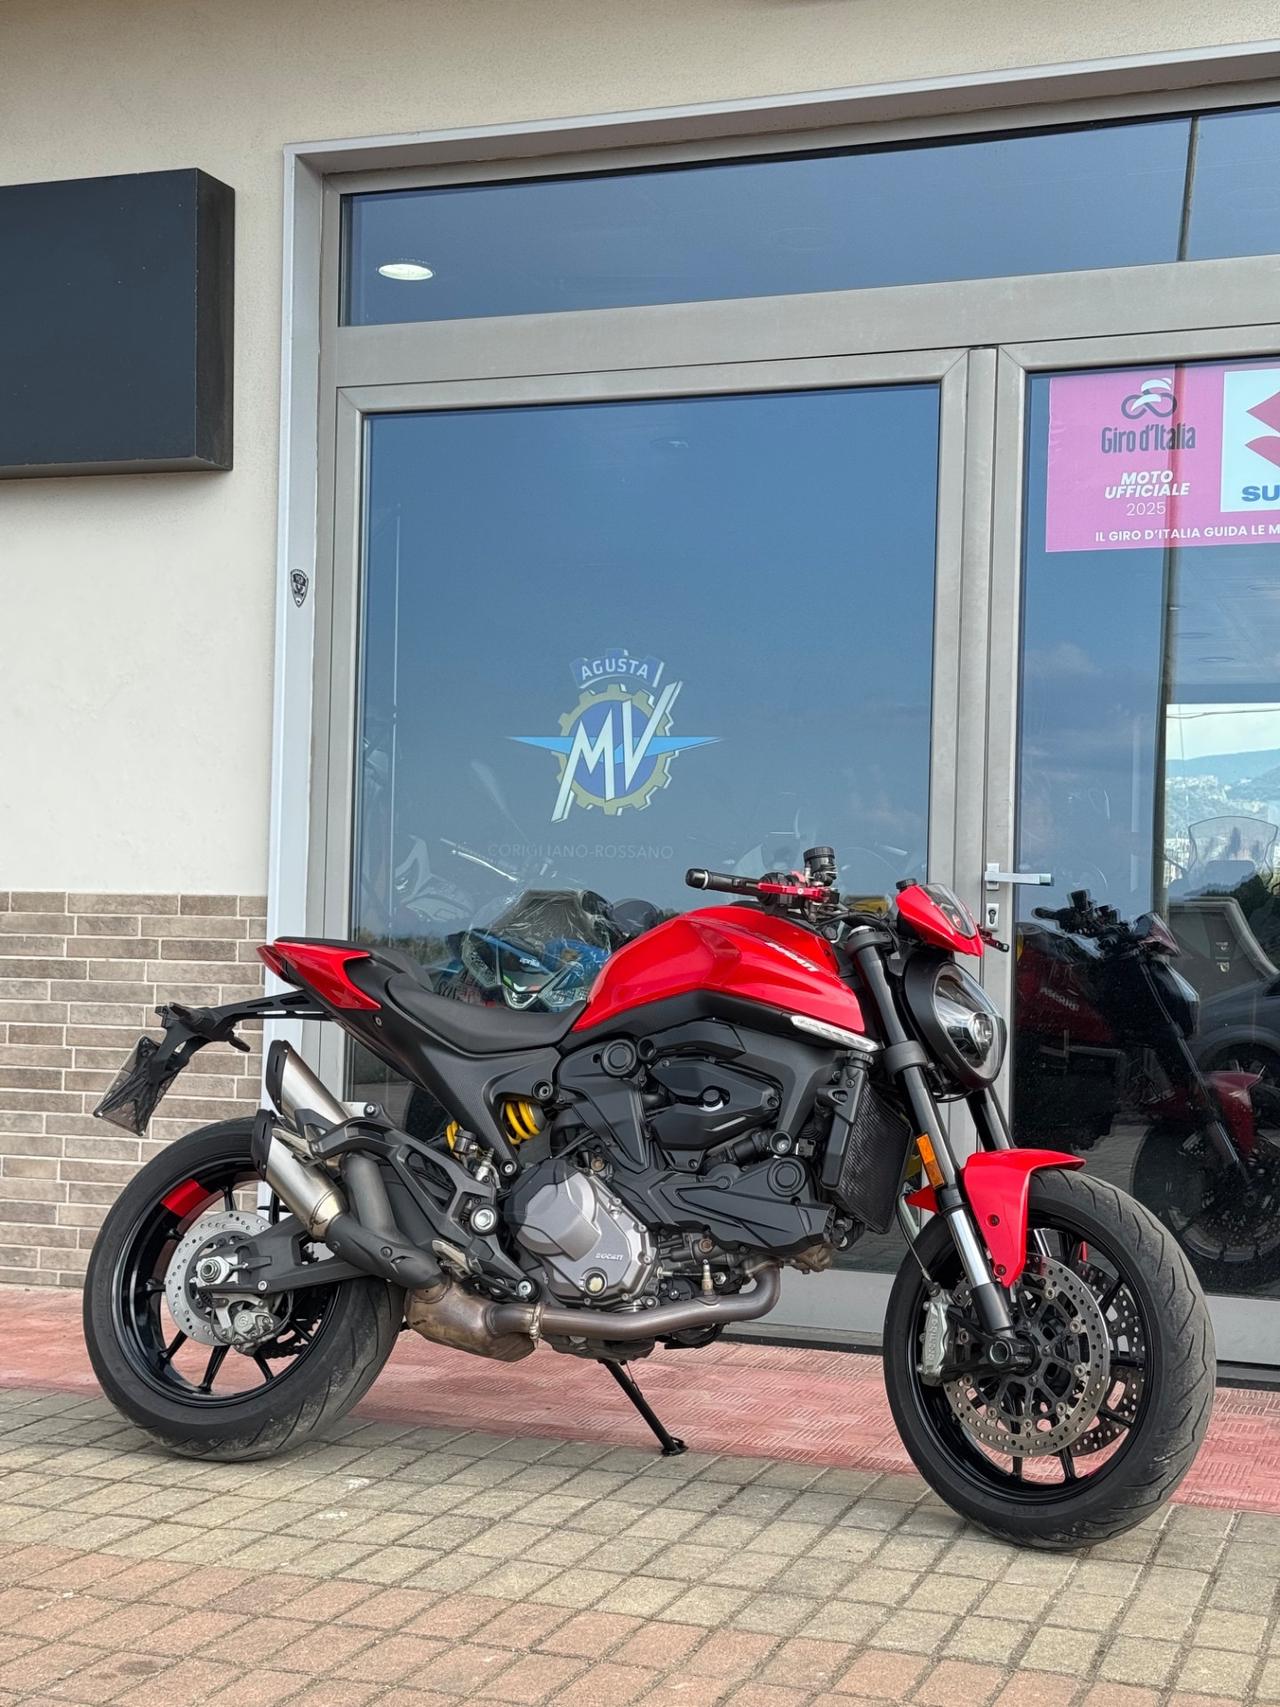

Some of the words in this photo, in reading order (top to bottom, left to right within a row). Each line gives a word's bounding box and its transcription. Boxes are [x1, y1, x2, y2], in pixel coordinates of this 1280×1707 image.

[1101, 426, 1137, 454] Giro
[1139, 422, 1196, 452] d'Italia
[1120, 470, 1174, 486] MOTO
[1104, 482, 1191, 499] UFFICIALE
[1126, 501, 1167, 516] 2025
[1095, 531, 1106, 542] IL
[1108, 529, 1142, 541] GIRO
[1144, 527, 1201, 540] D'ITALIA
[1203, 525, 1248, 537] GUIDA
[1251, 524, 1265, 535] LE
[580, 657, 650, 681] AGUSTA
[551, 681, 678, 822] MV
[487, 843, 675, 860] CORIGLIANO-ROSSANO
